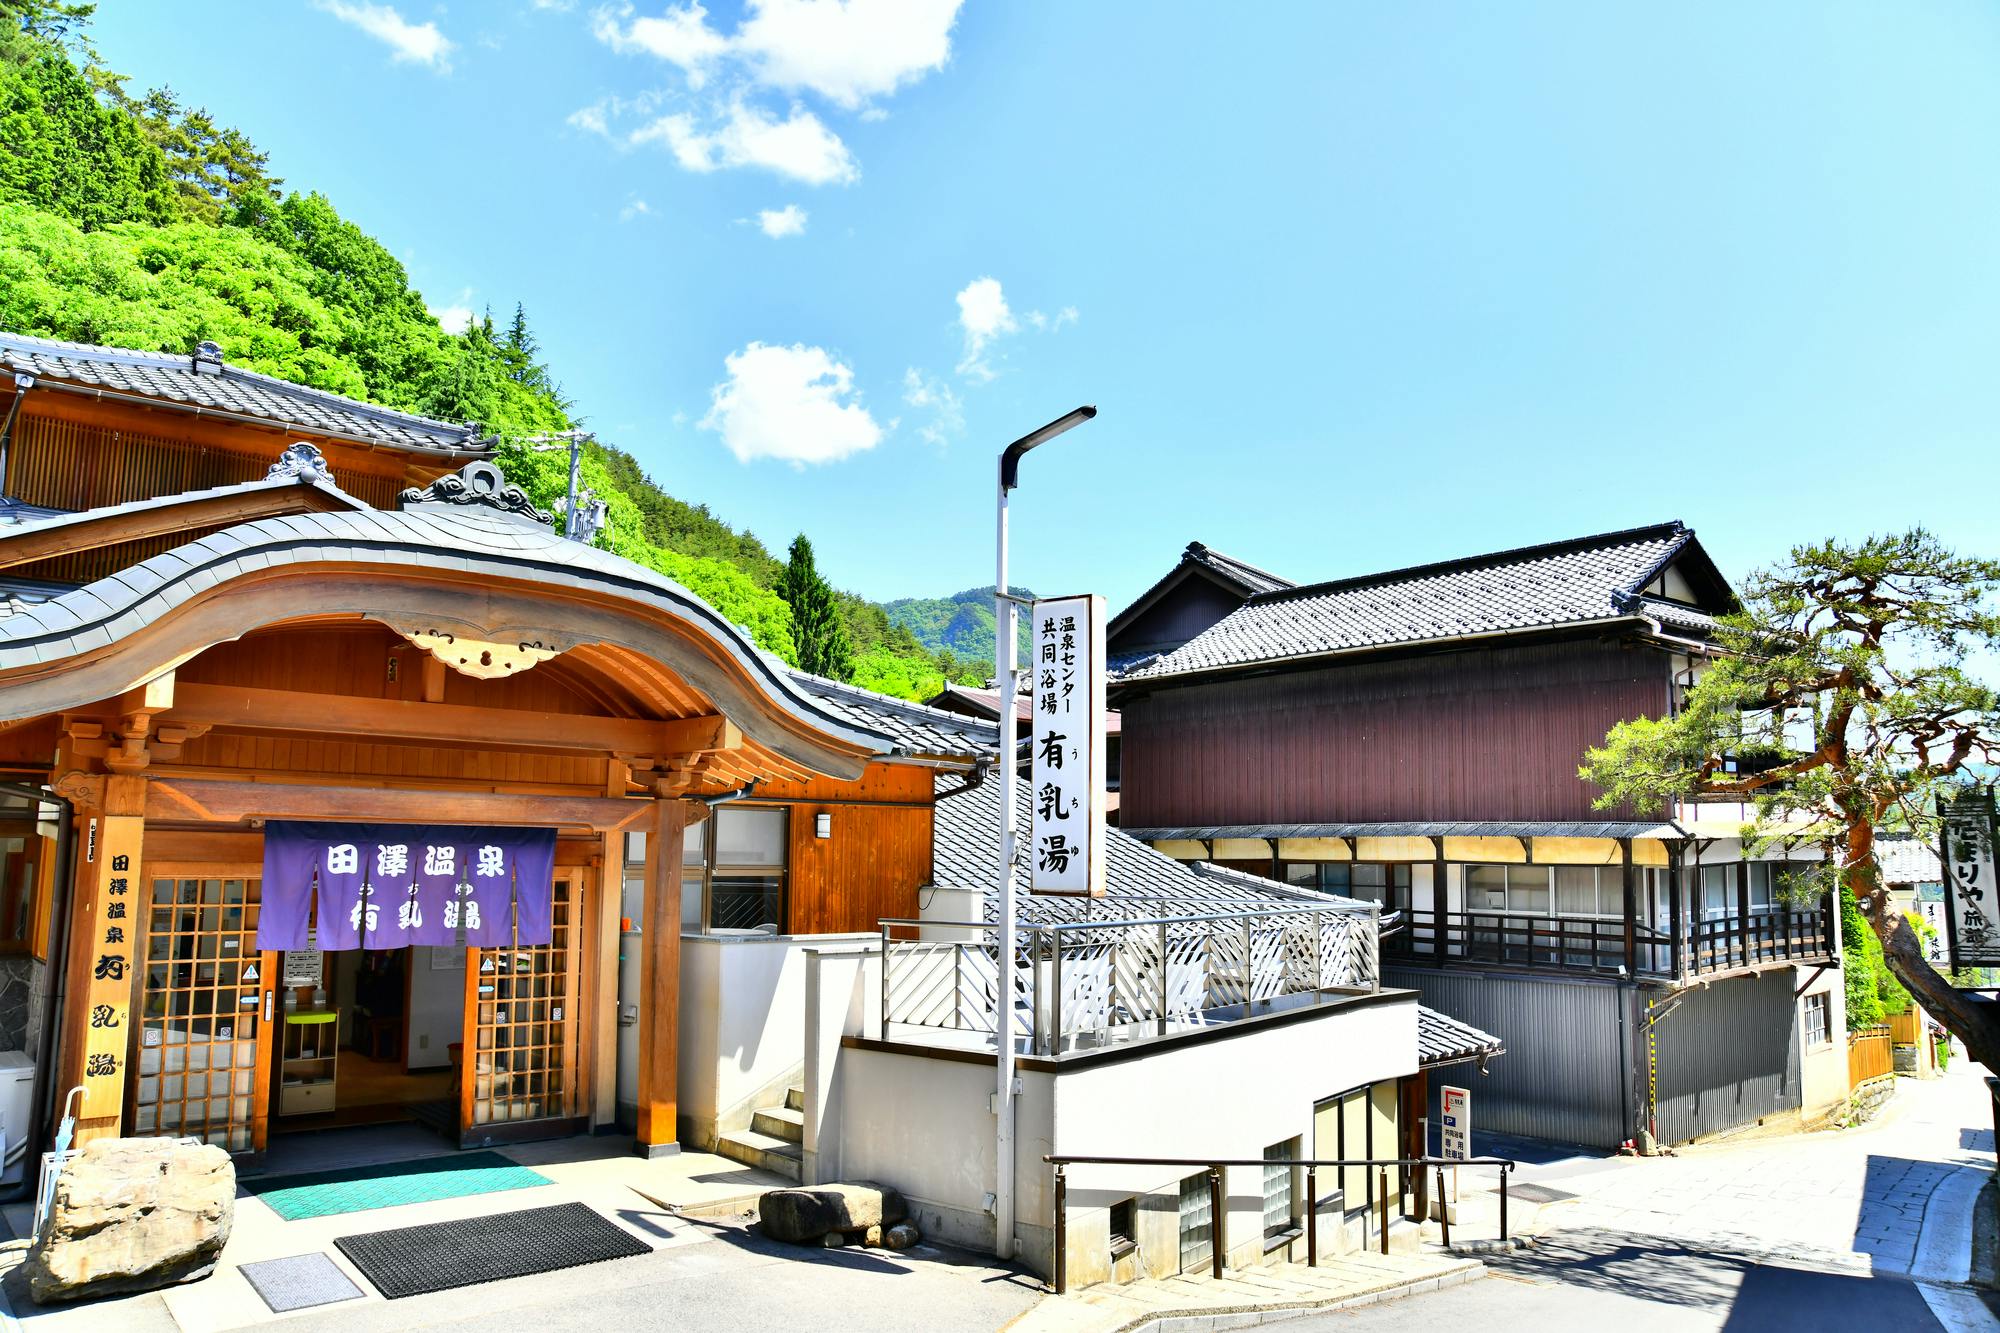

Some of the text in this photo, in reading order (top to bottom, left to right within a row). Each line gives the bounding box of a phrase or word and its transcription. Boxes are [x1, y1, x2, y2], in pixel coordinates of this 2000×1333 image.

[1040, 619, 1058, 715] 共同浴場
[1059, 616, 1076, 713] 温泉センター
[1037, 730, 1070, 875] 有乳湯
